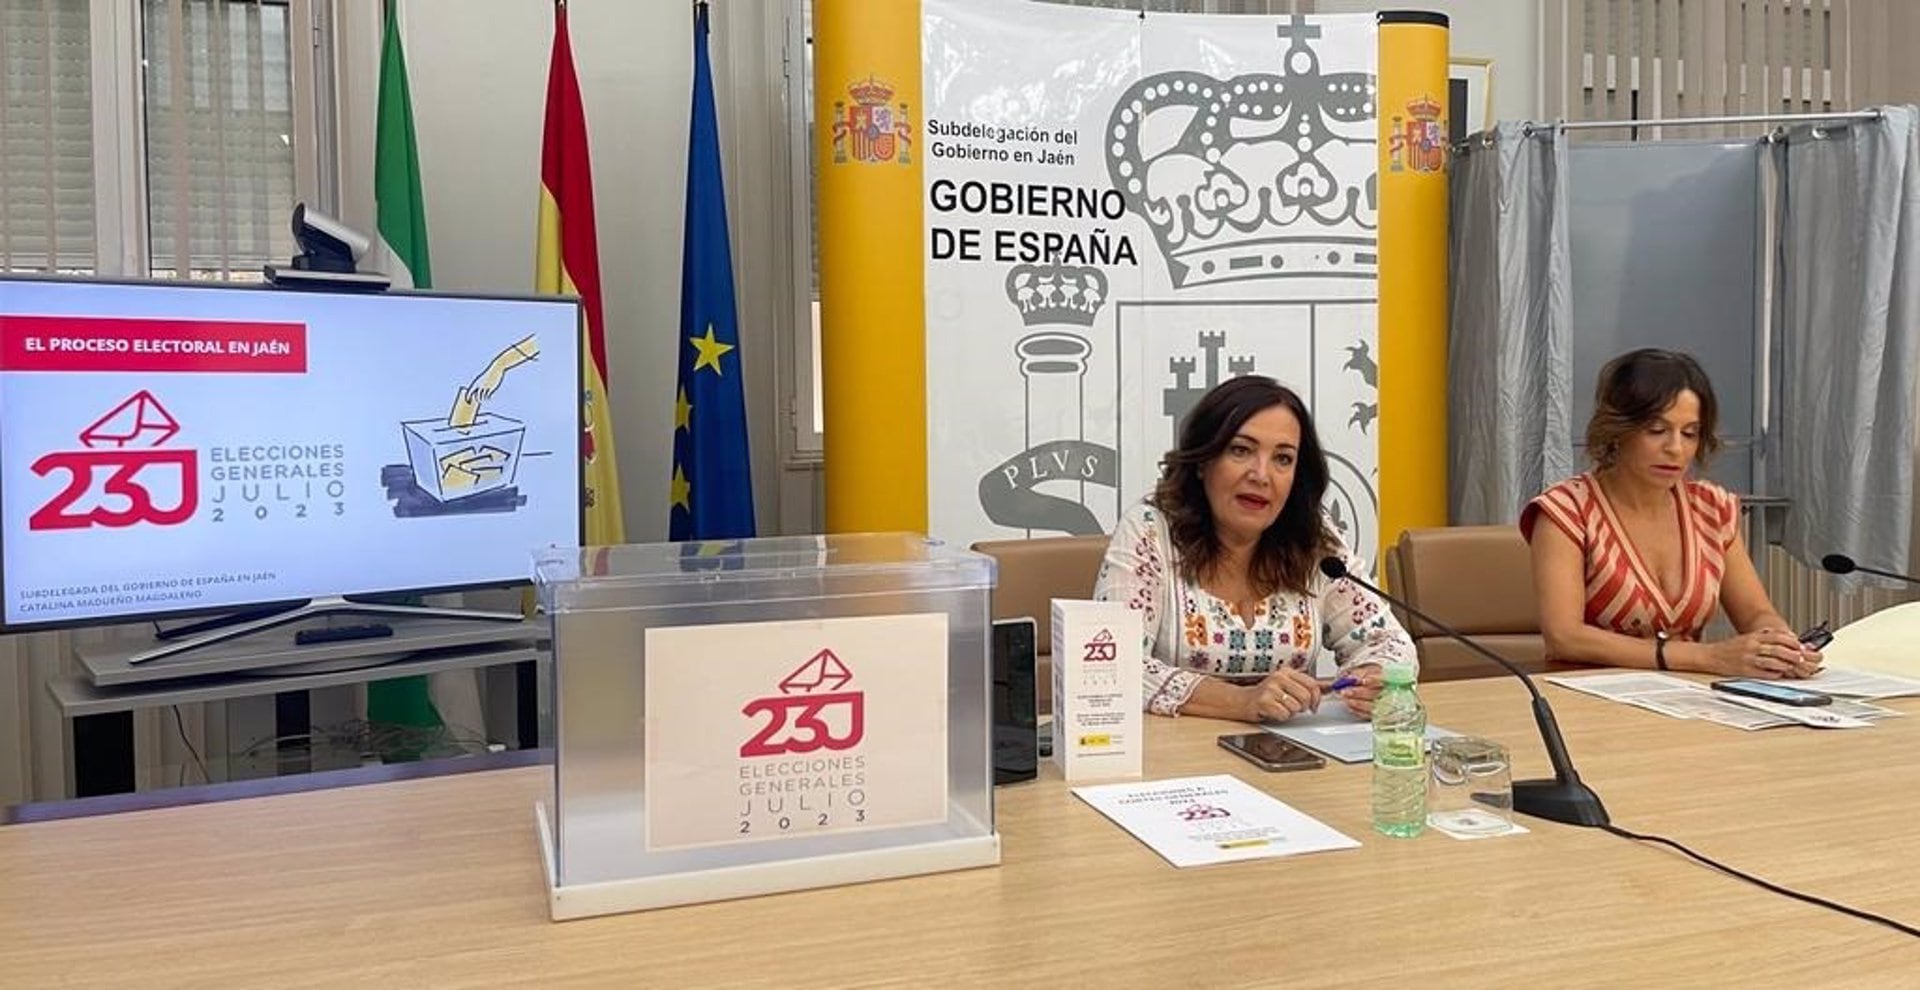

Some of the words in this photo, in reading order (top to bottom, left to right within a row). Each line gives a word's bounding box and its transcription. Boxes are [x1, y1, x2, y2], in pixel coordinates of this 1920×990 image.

[928, 120, 1049, 143] Subdelegación
[1054, 130, 1078, 145] del
[932, 142, 1009, 162] Gobierno
[1014, 151, 1033, 163] en
[1038, 150, 1075, 165] Jaén
[930, 179, 1126, 220] GOBIERNO
[931, 228, 981, 260] DE
[995, 228, 1138, 266] ESPAÑA
[25, 337, 45, 351] EL
[50, 338, 129, 352] PROCESO
[134, 339, 224, 354] ELECTORAL
[229, 341, 250, 354] EN
[253, 339, 290, 356] JAÉN
[211, 444, 344, 462] ELECCIONES
[211, 463, 344, 481] GENERALES
[1003, 449, 1098, 489] PLVS
[211, 480, 344, 503] JULIO
[212, 502, 344, 522] 2023
[20, 586, 98, 599] SUBDELEGADA
[101, 584, 119, 593] DEL
[123, 580, 177, 591] GOBIERNO
[180, 577, 193, 587] DE
[196, 574, 235, 585] ESPAÑA
[238, 574, 250, 583] EN
[20, 601, 74, 612] CATALINA
[740, 756, 865, 779] ELECCIONES
[740, 773, 865, 796] GENERALES
[740, 789, 865, 816] JULIO
[740, 810, 865, 833] 2023
